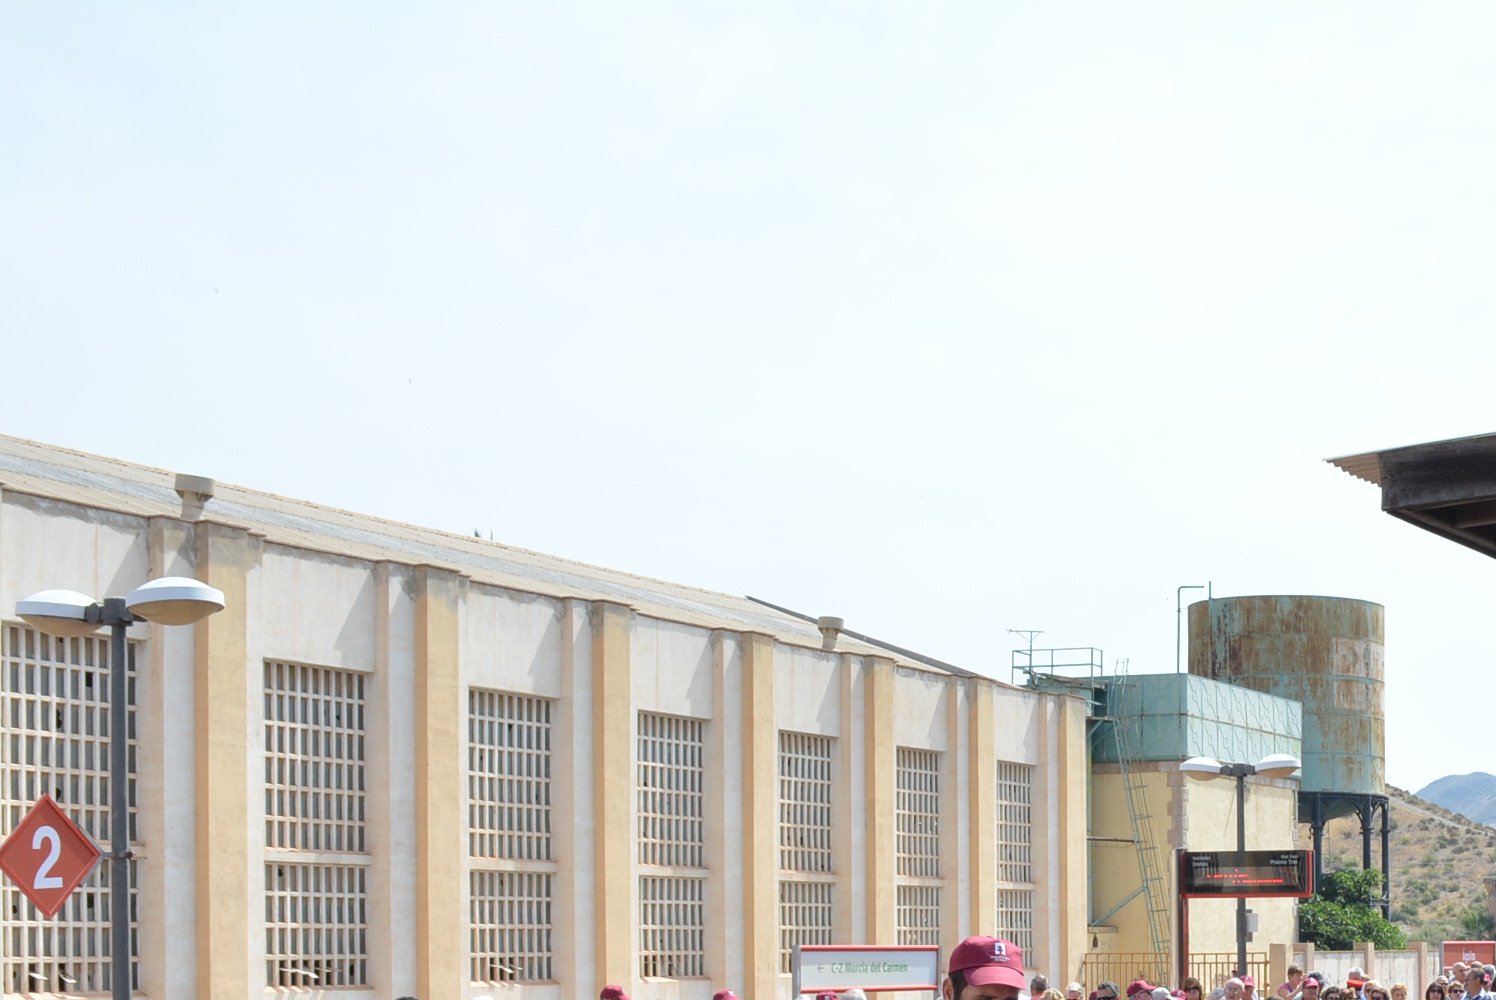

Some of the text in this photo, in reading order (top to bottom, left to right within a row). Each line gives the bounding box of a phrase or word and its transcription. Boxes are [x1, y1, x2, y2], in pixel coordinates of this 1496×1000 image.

[32, 826, 63, 889] 2
[831, 962, 908, 973] C-2 Murcia del Carmen
